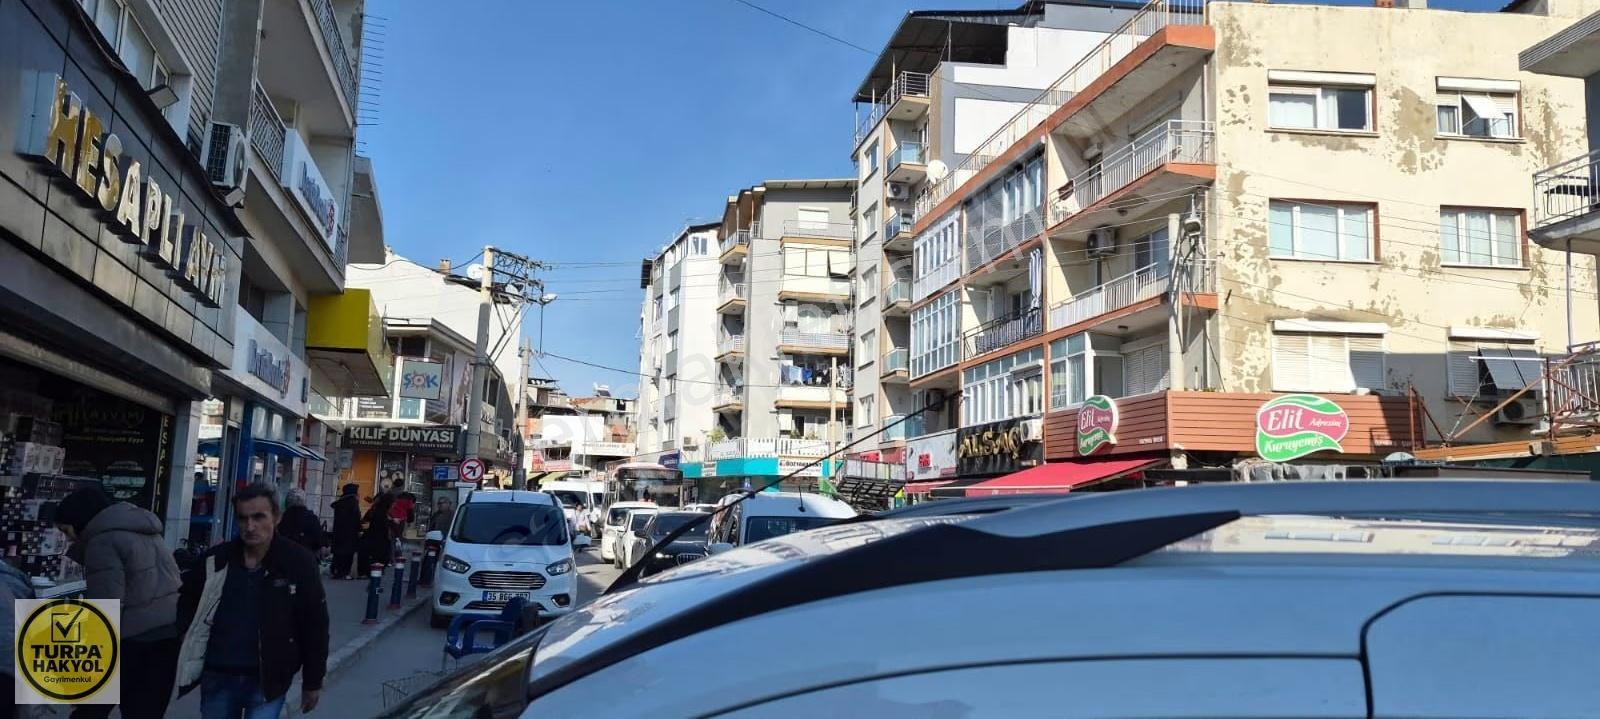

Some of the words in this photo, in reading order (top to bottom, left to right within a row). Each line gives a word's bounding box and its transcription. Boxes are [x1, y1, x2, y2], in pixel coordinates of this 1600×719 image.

[45, 73, 185, 272] HESAPLI
[1080, 408, 1096, 430] Elit
[1267, 408, 1304, 431] Elit
[349, 426, 388, 440] KILIF
[389, 424, 455, 443] DÜNYASI
[1263, 433, 1325, 454] Kuruyemiş
[487, 592, 497, 601] 35
